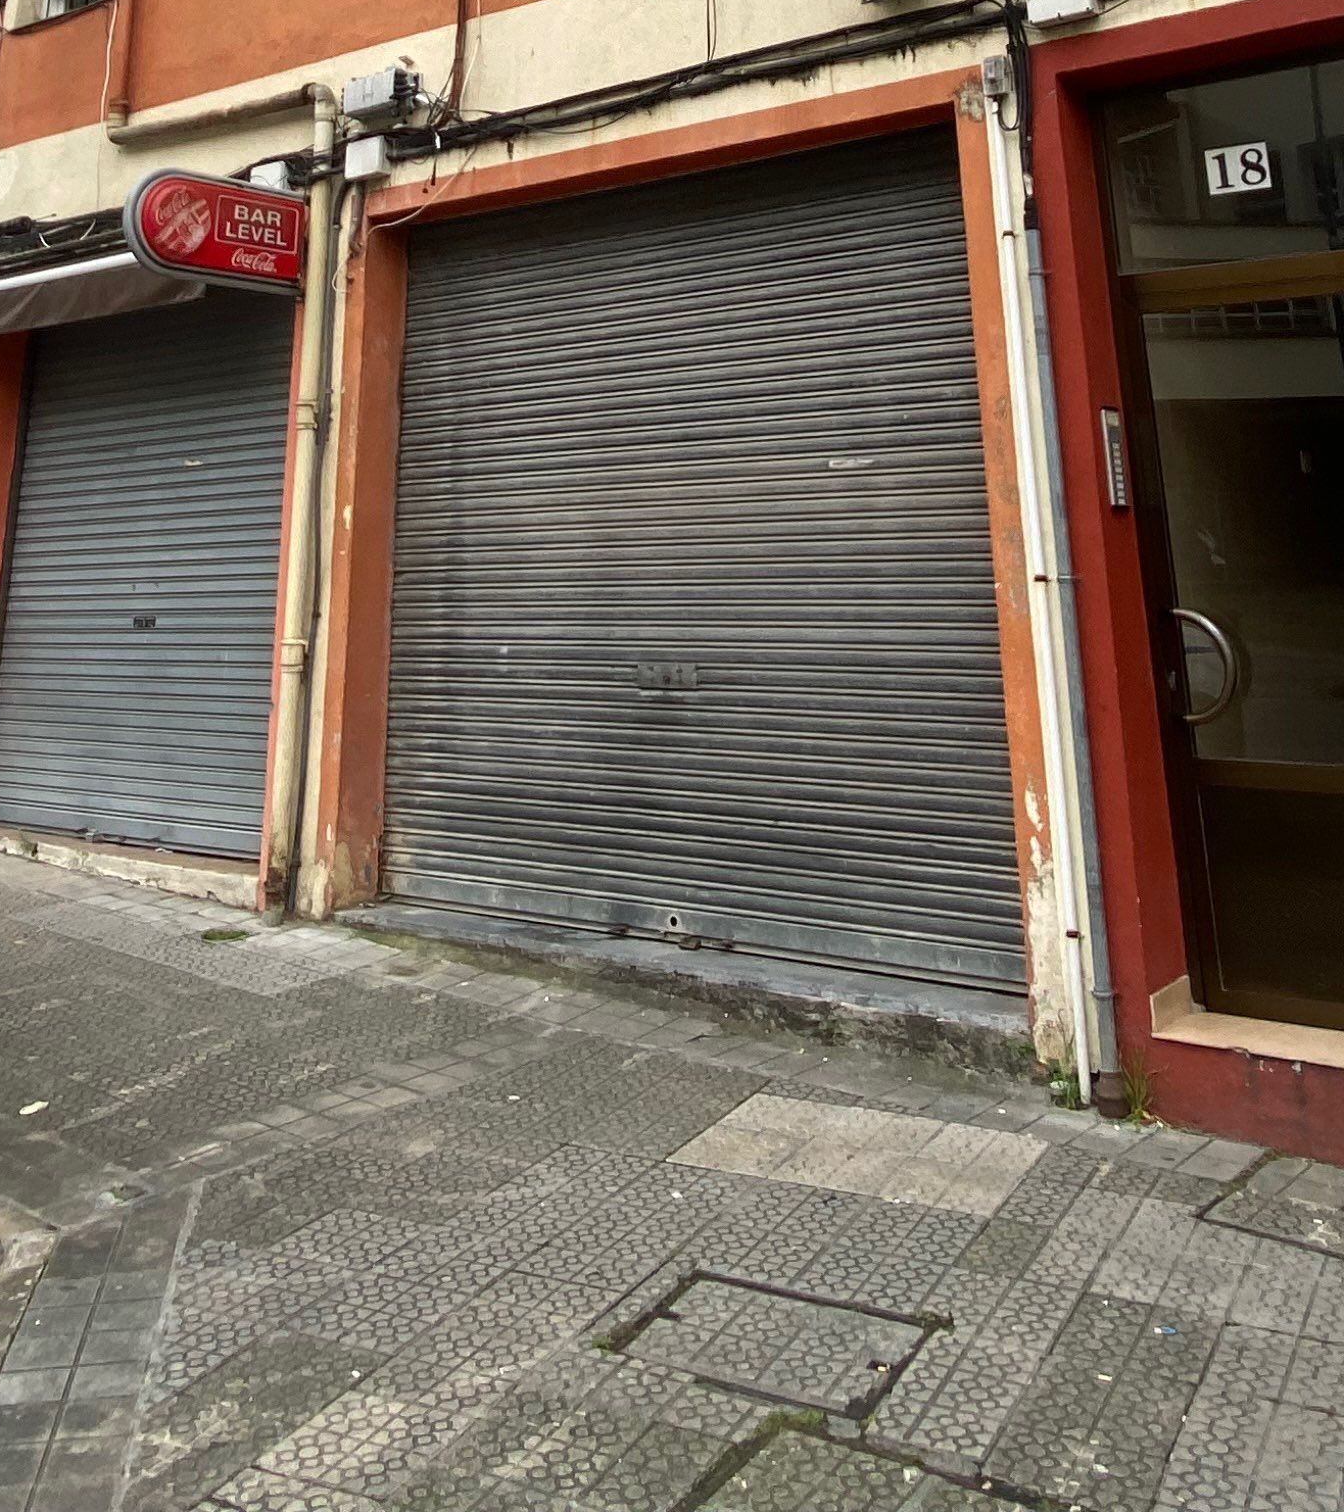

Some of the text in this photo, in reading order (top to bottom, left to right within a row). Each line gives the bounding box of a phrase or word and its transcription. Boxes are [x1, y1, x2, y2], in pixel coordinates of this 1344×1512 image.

[1211, 148, 1267, 190] 18
[233, 204, 282, 228] BAR
[225, 220, 287, 247] LEVEL
